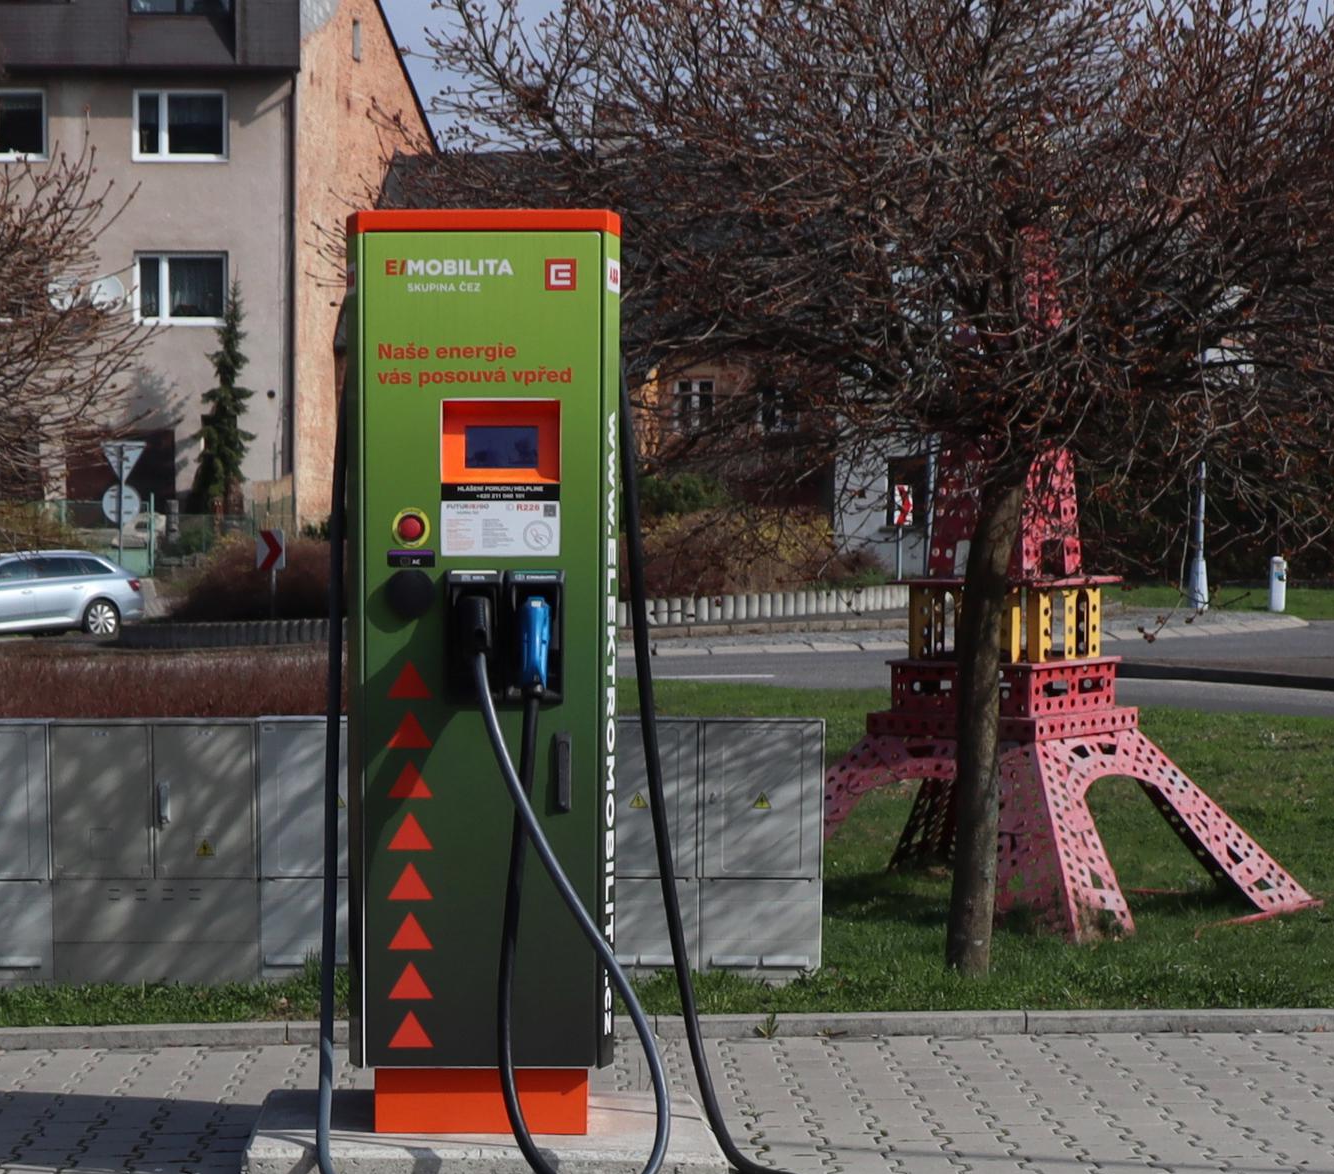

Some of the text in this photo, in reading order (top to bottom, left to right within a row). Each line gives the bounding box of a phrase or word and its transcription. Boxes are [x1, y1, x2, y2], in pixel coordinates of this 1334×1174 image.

[407, 281, 481, 292] SKUPINA ČEZ
[378, 343, 517, 363] Naše energie
[378, 366, 572, 387] vás posouvá vpřed
